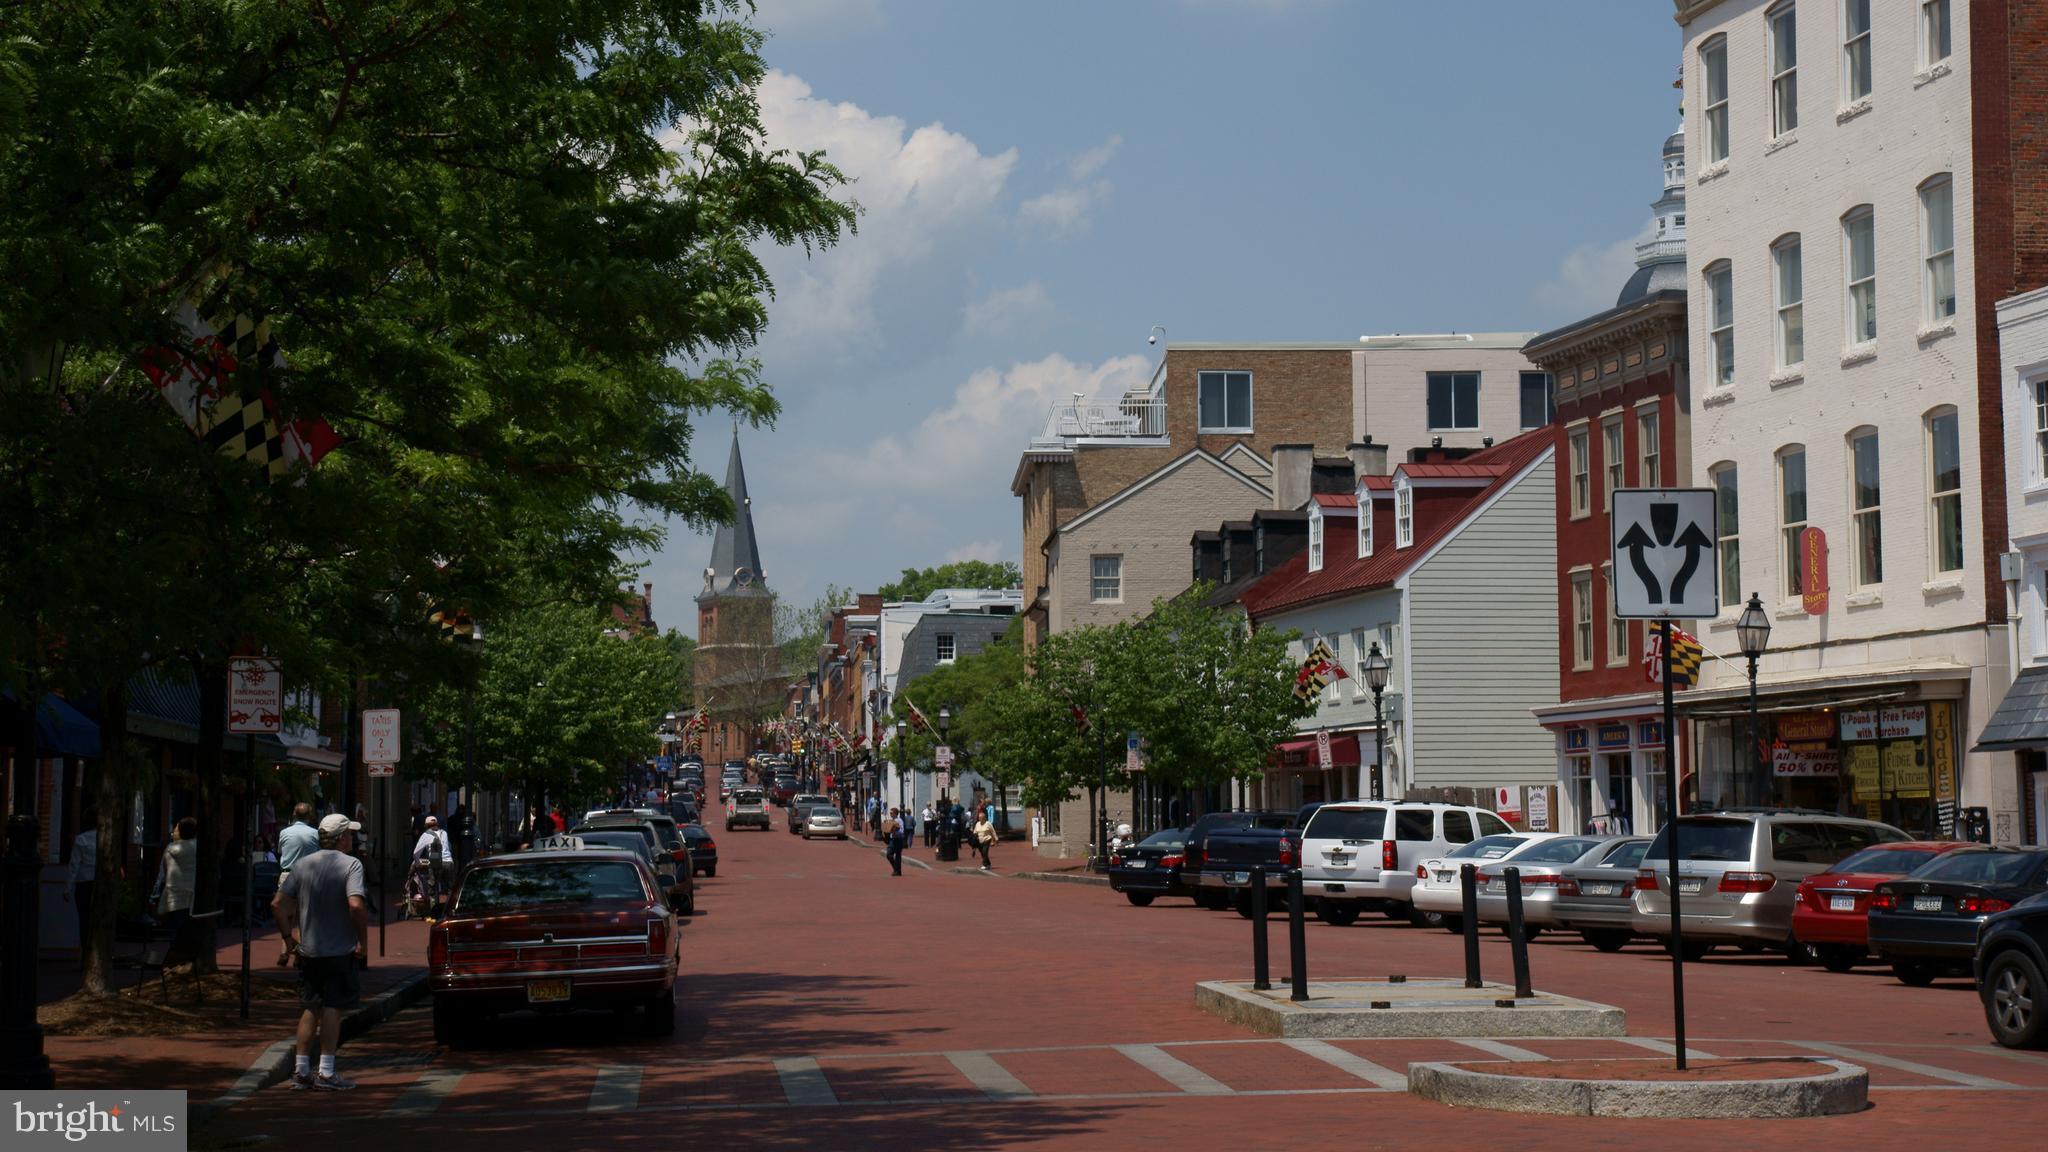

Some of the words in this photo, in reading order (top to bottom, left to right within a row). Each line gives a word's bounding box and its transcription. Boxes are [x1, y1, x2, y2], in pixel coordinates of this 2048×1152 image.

[1809, 530, 1819, 592] GENERAL
[1804, 592, 1827, 603] Store
[371, 717, 391, 725] TAXIS
[1841, 713, 1845, 725] 1
[1847, 712, 1871, 725] Pound
[1882, 711, 1899, 723] Free
[1902, 707, 1925, 722] Fudge
[371, 729, 391, 737] ONLY
[1784, 722, 1809, 738] General
[1810, 722, 1829, 737] Store
[1856, 728, 1873, 738] with
[378, 738, 384, 749] 2
[1775, 752, 1791, 761] All
[1794, 751, 1840, 761] T-SHIRT
[1886, 751, 1912, 768] FUDGE
[1777, 762, 1808, 773] 50%
[1813, 762, 1840, 773] OFF
[540, 838, 576, 848] TAXI
